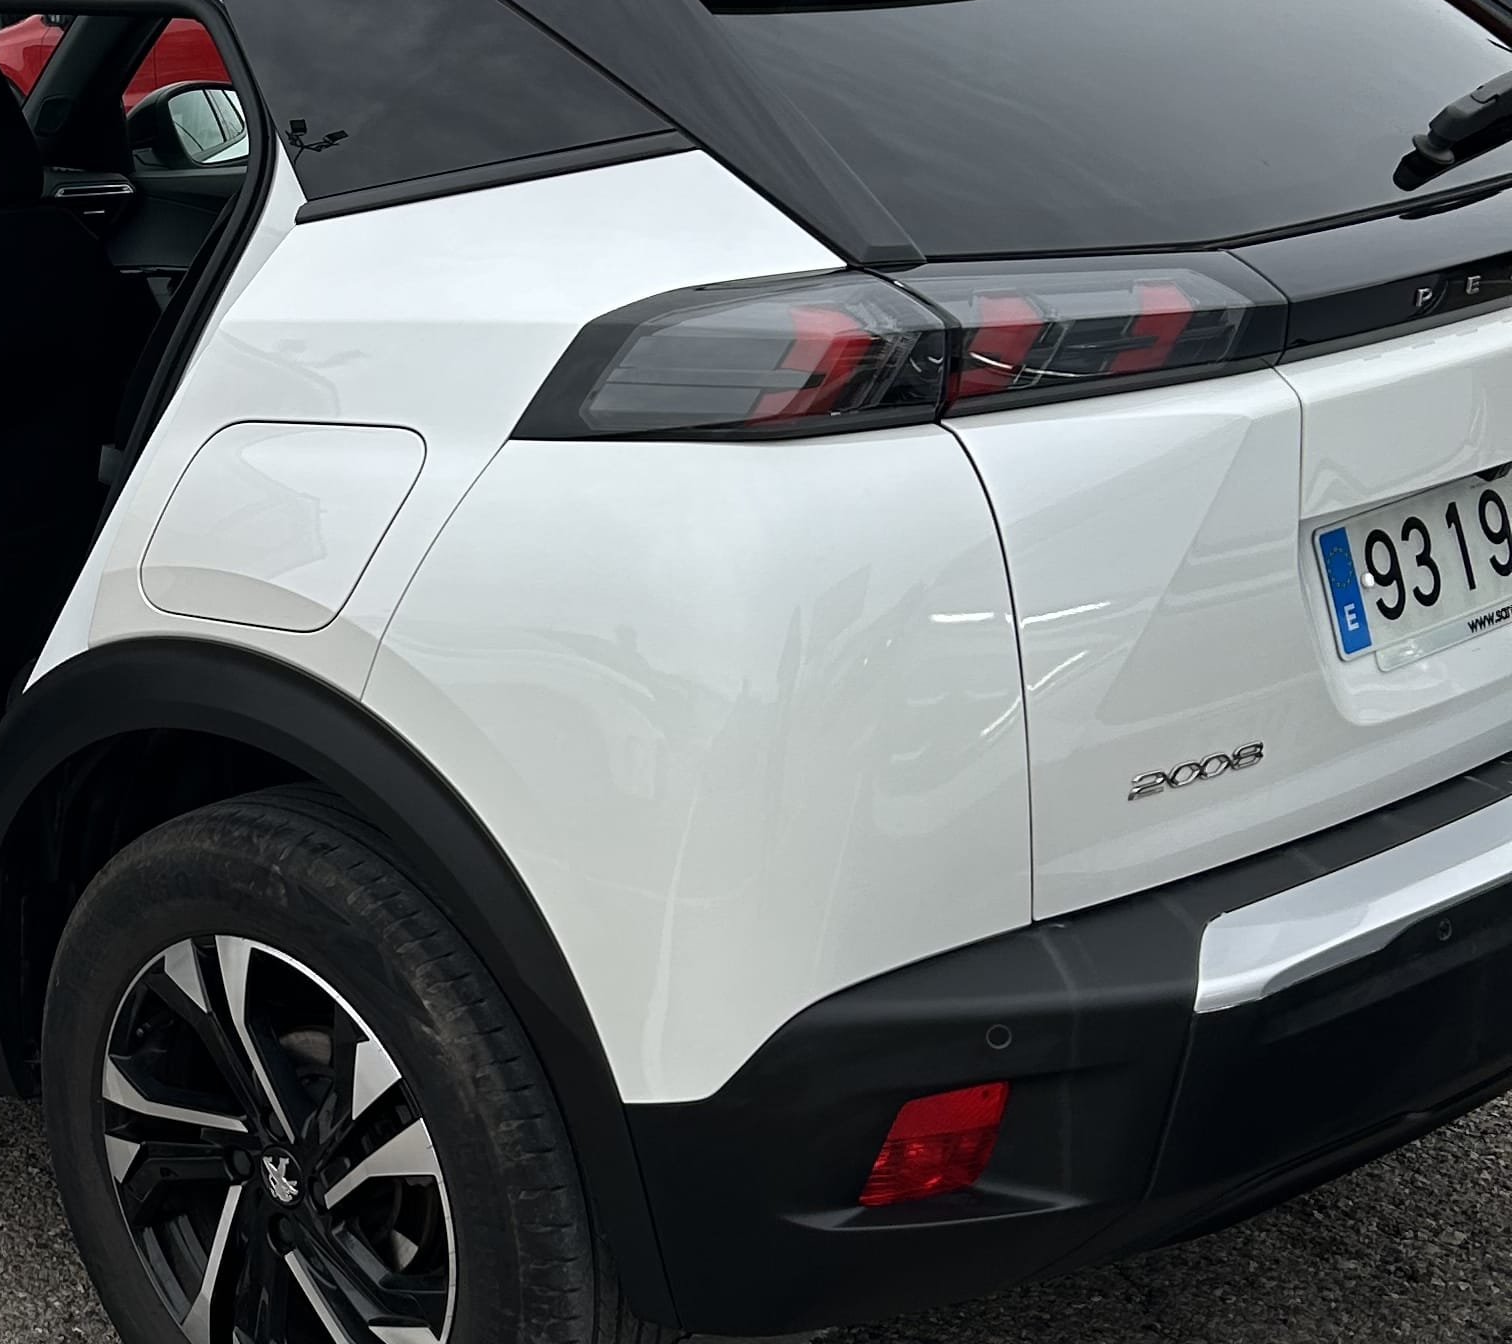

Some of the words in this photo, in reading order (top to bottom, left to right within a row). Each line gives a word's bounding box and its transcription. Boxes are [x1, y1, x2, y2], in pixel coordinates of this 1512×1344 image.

[1415, 275, 1512, 307] PE
[1343, 603, 1360, 631] E
[1364, 489, 1512, 620] 9319
[1128, 741, 1264, 801] 2008
